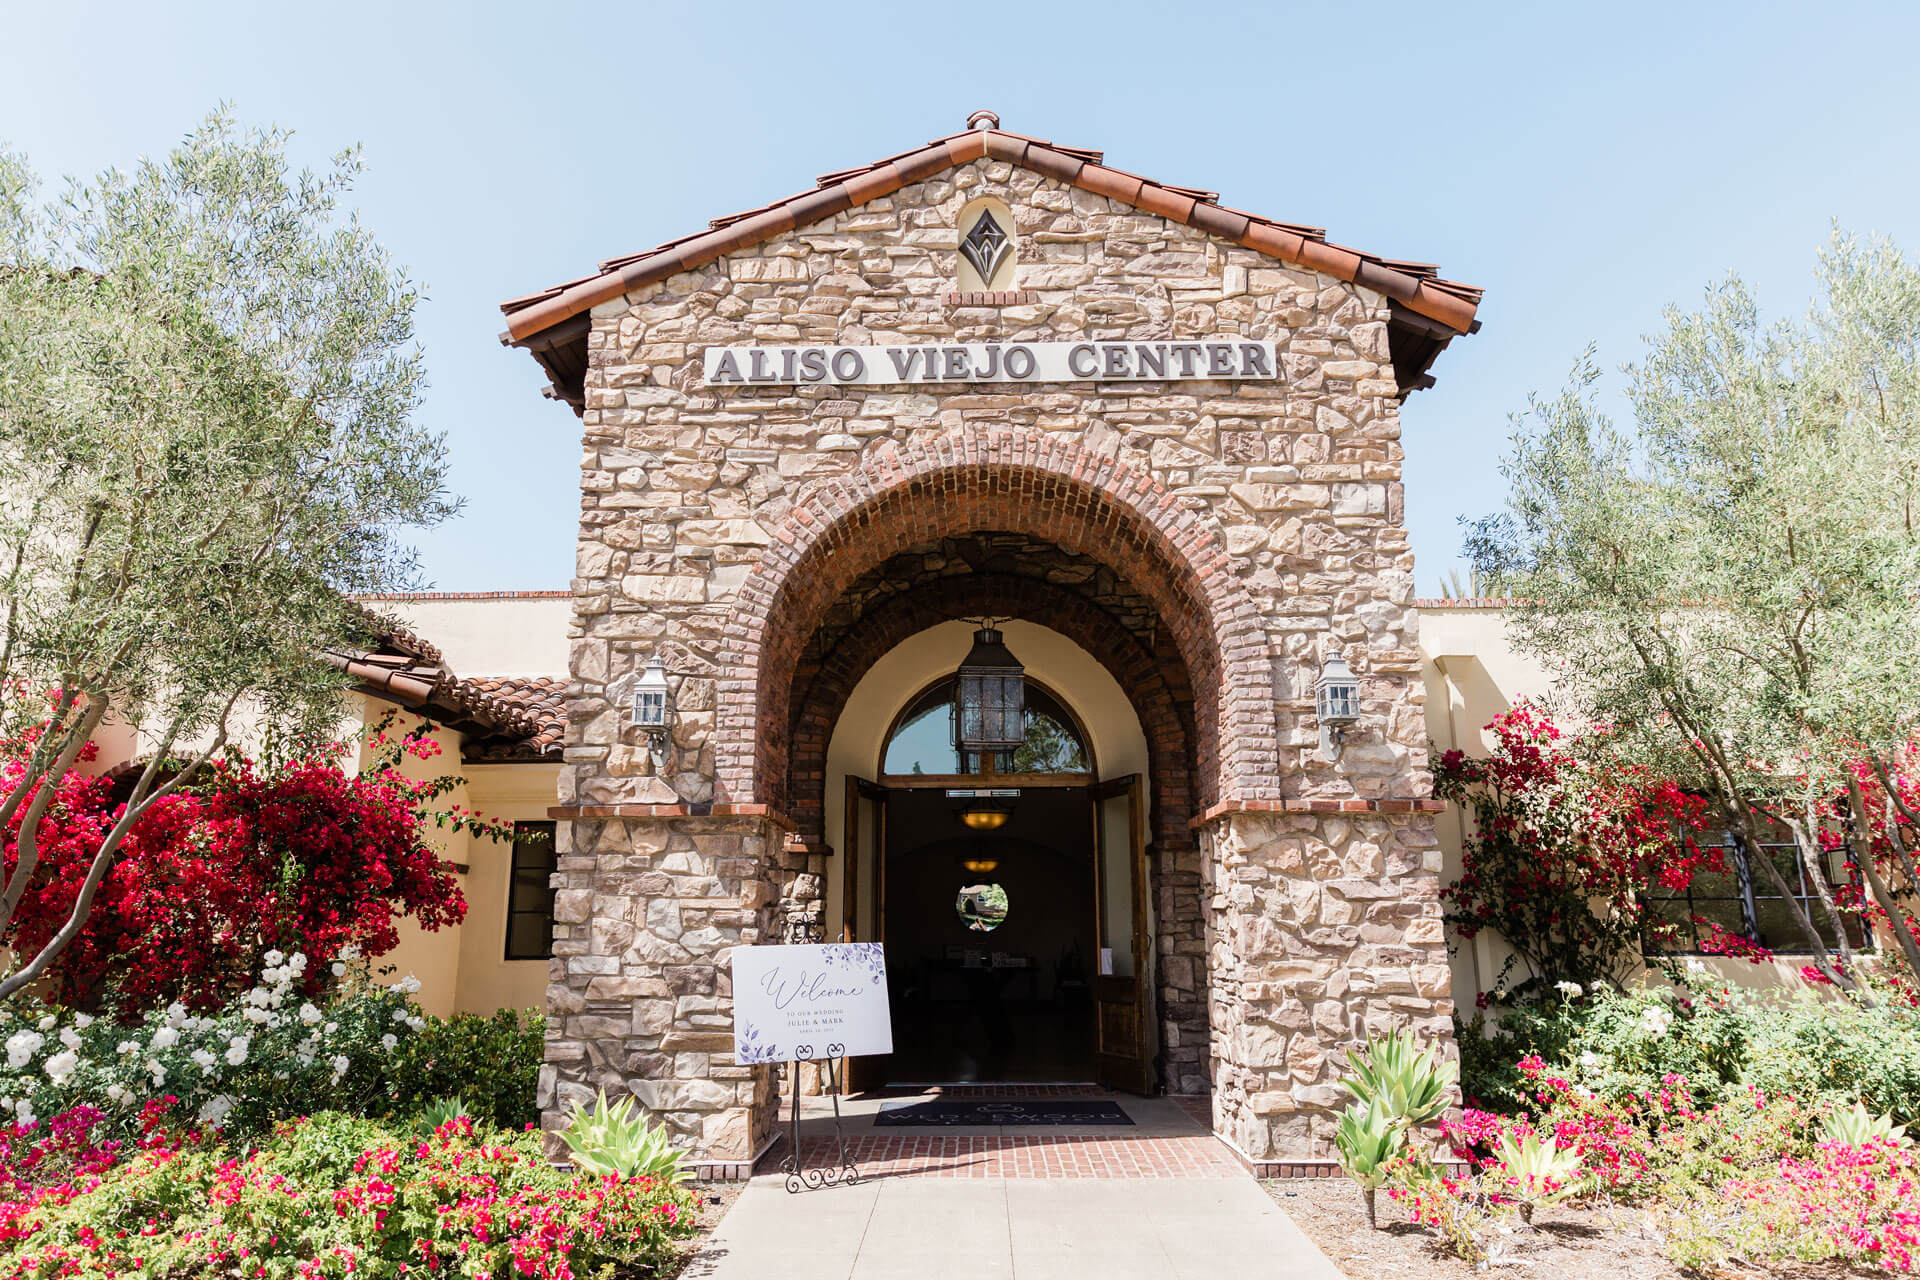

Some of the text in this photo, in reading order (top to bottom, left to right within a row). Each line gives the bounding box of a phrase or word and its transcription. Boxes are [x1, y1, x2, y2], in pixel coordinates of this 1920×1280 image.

[711, 343, 1272, 383] ALISO VIEJO CENTER
[761, 966, 864, 1010] Welcome
[788, 1019, 810, 1027] JULIE
[822, 1017, 844, 1025] MARK
